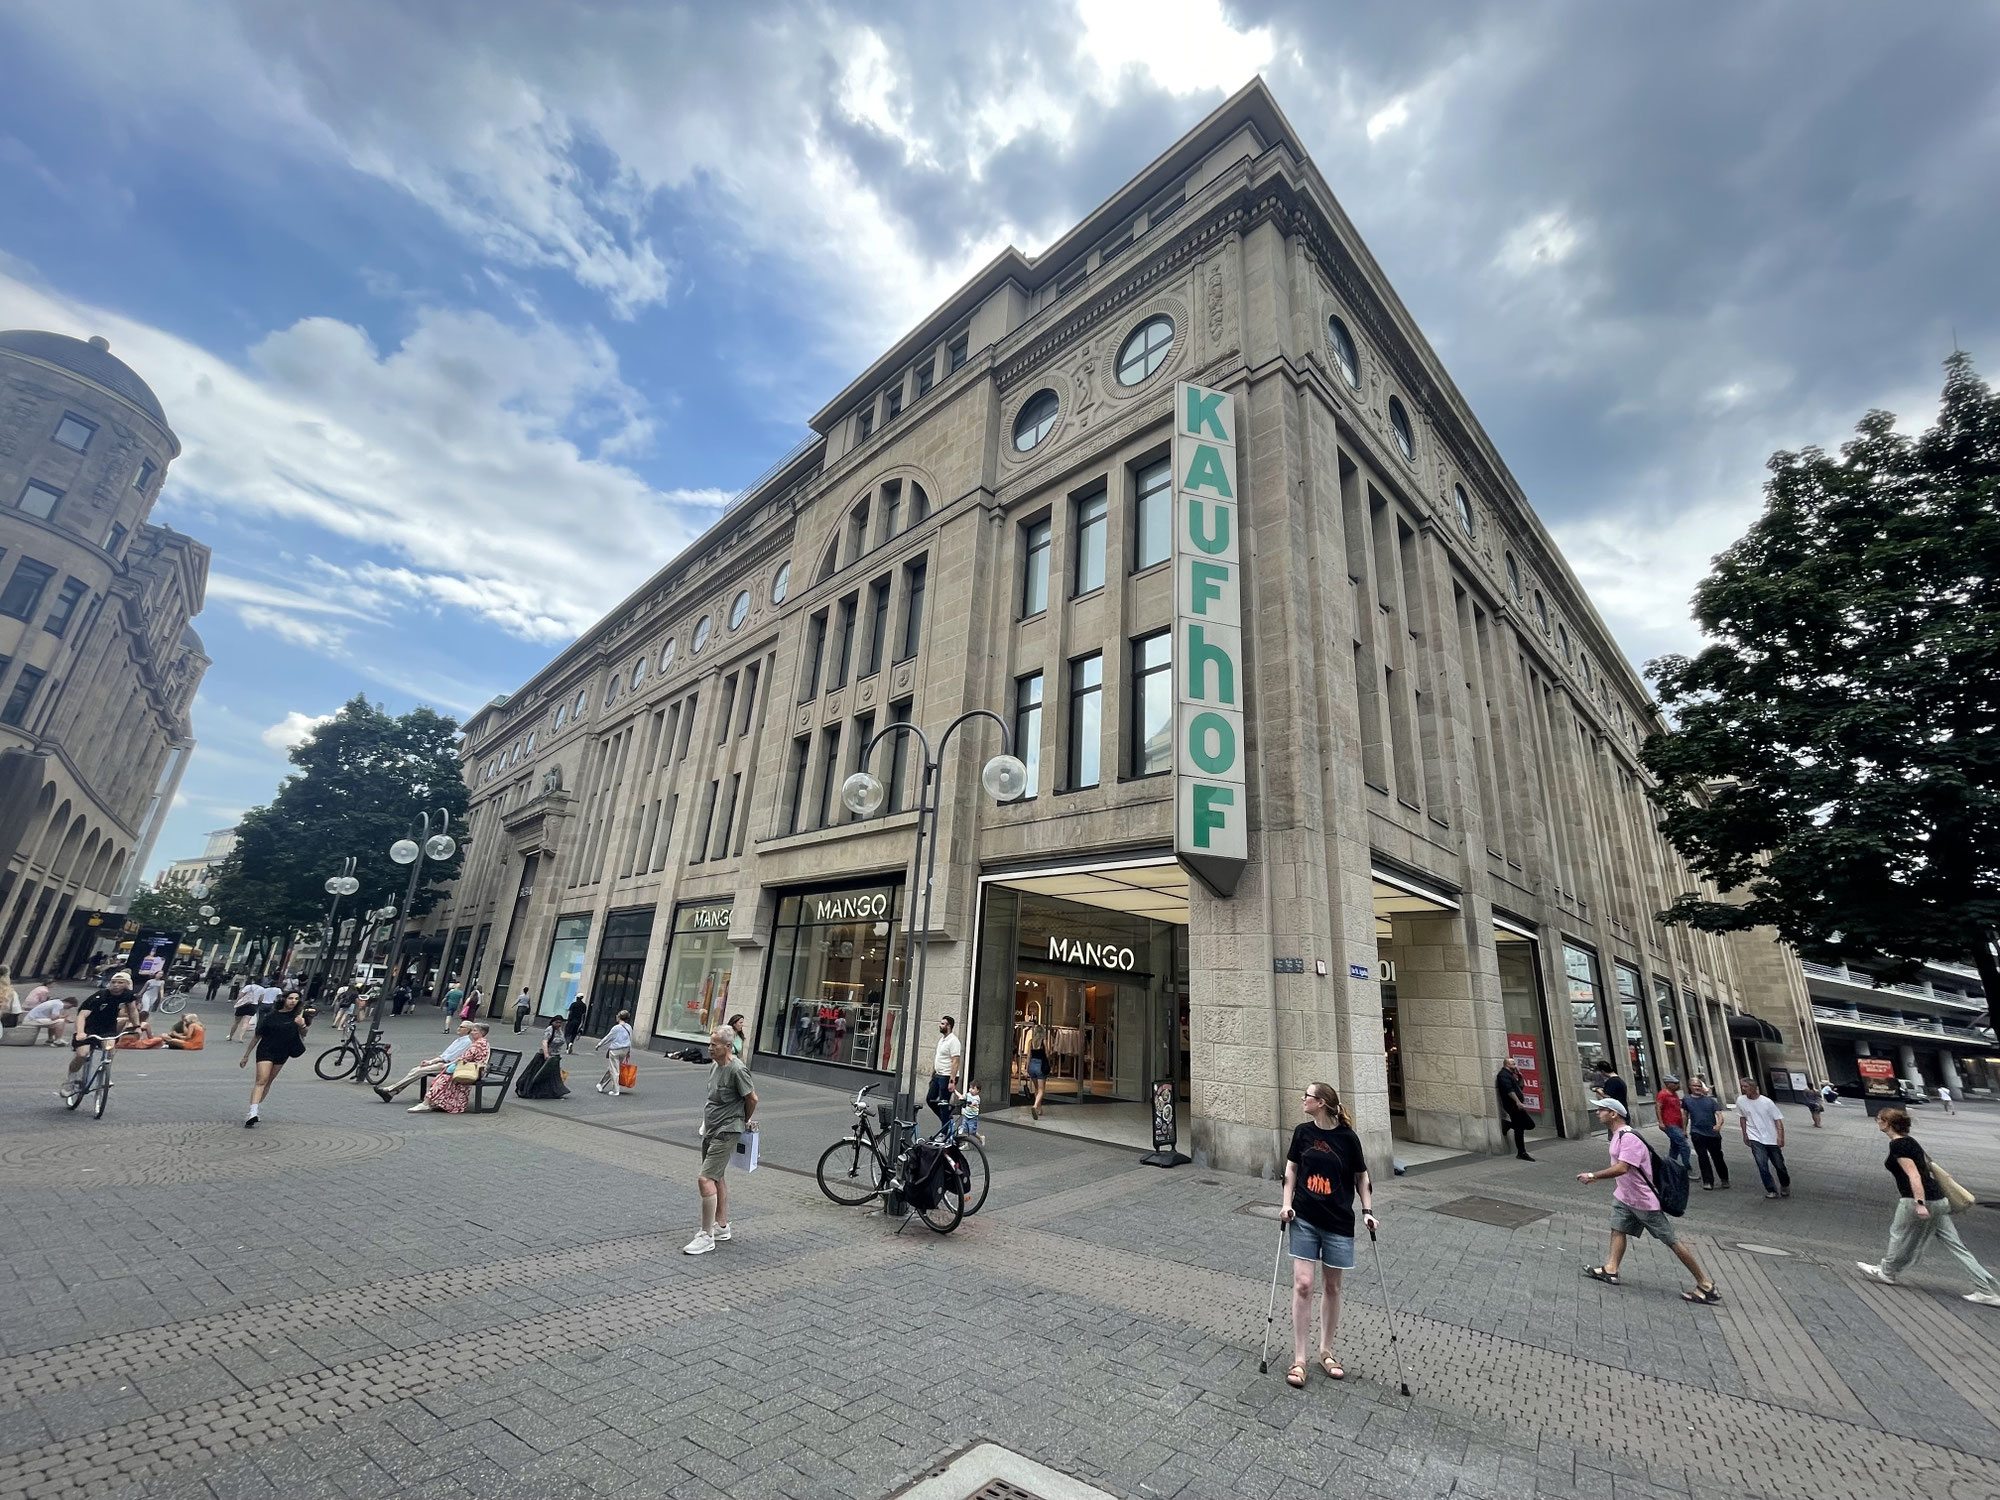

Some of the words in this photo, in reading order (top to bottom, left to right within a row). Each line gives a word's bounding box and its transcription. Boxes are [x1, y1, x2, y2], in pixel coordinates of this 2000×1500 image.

[817, 893, 887, 920] MANGO
[1048, 936, 1135, 971] MANGO
[819, 1008, 839, 1020] SALE
[1510, 1040, 1534, 1049] SALE
